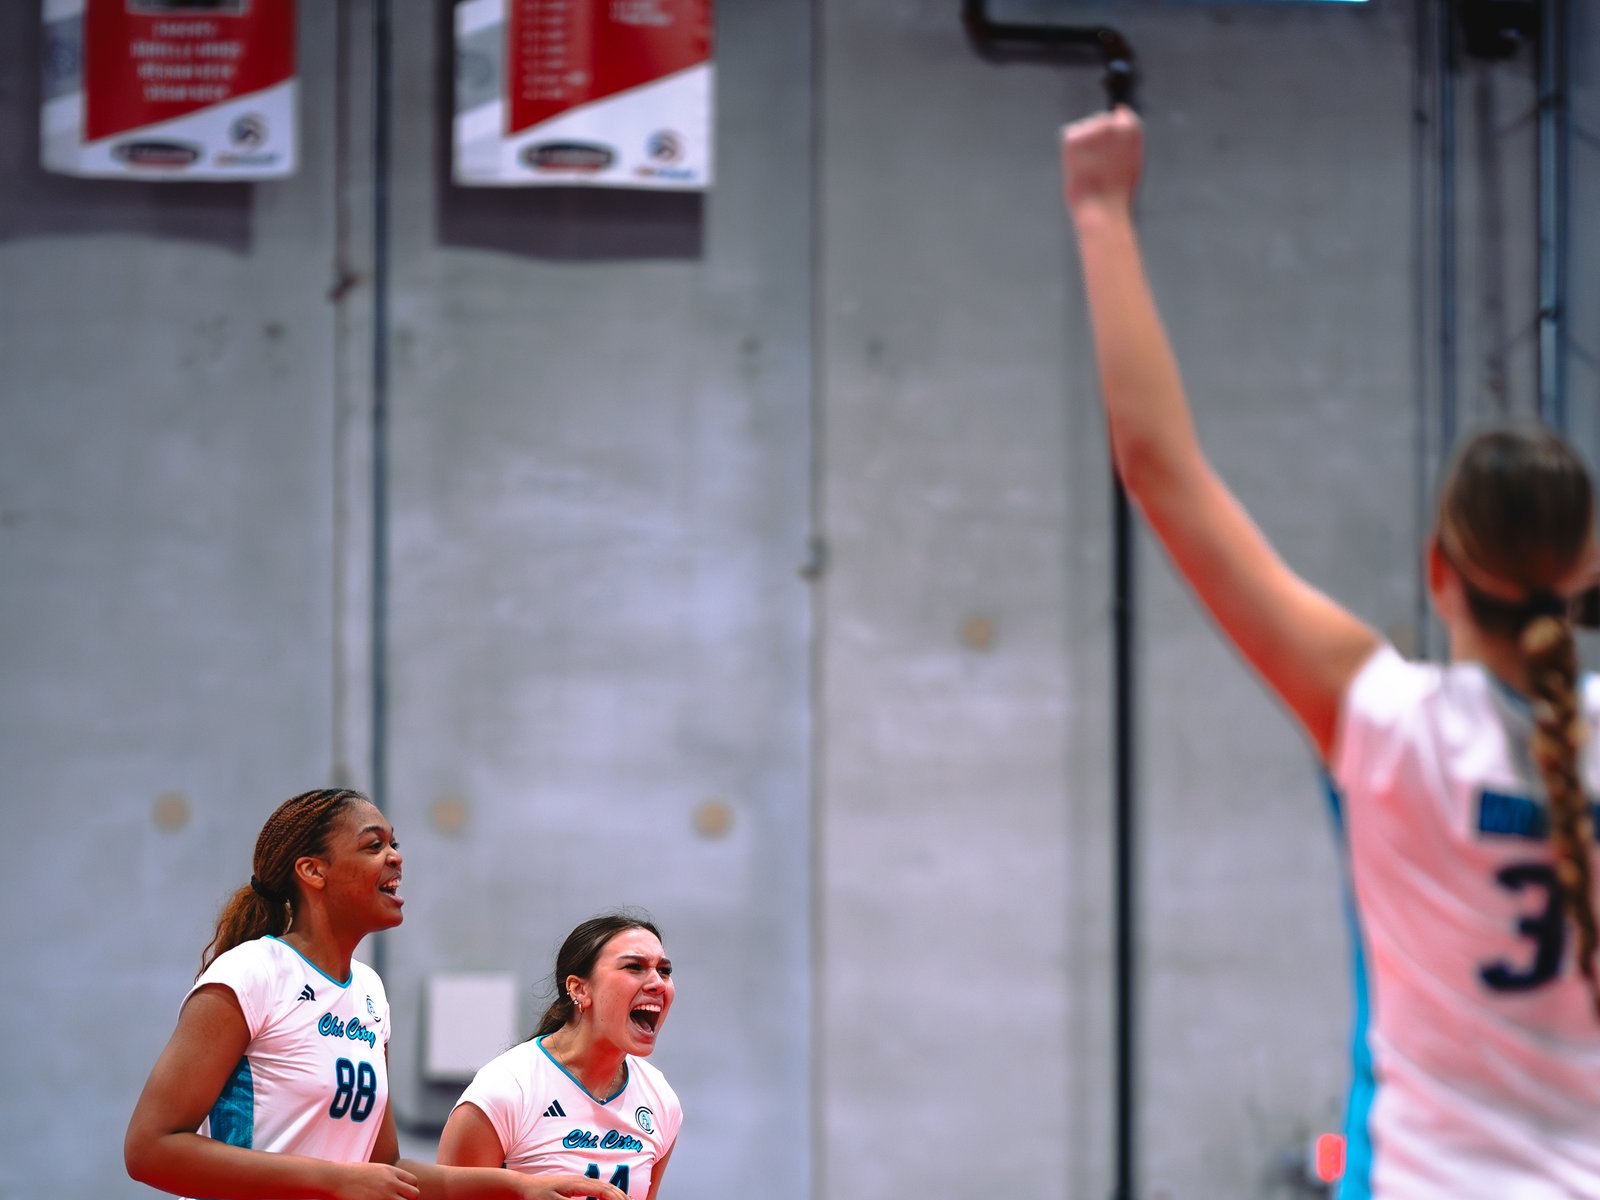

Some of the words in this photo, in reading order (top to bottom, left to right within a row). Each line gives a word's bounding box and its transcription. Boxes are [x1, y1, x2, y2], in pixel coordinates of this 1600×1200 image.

[1477, 863, 1565, 992] 3
[318, 1012, 344, 1037] Chi
[345, 1017, 377, 1049] City
[329, 1057, 377, 1122] 88
[563, 1129, 598, 1149] Chi
[600, 1129, 643, 1153] City
